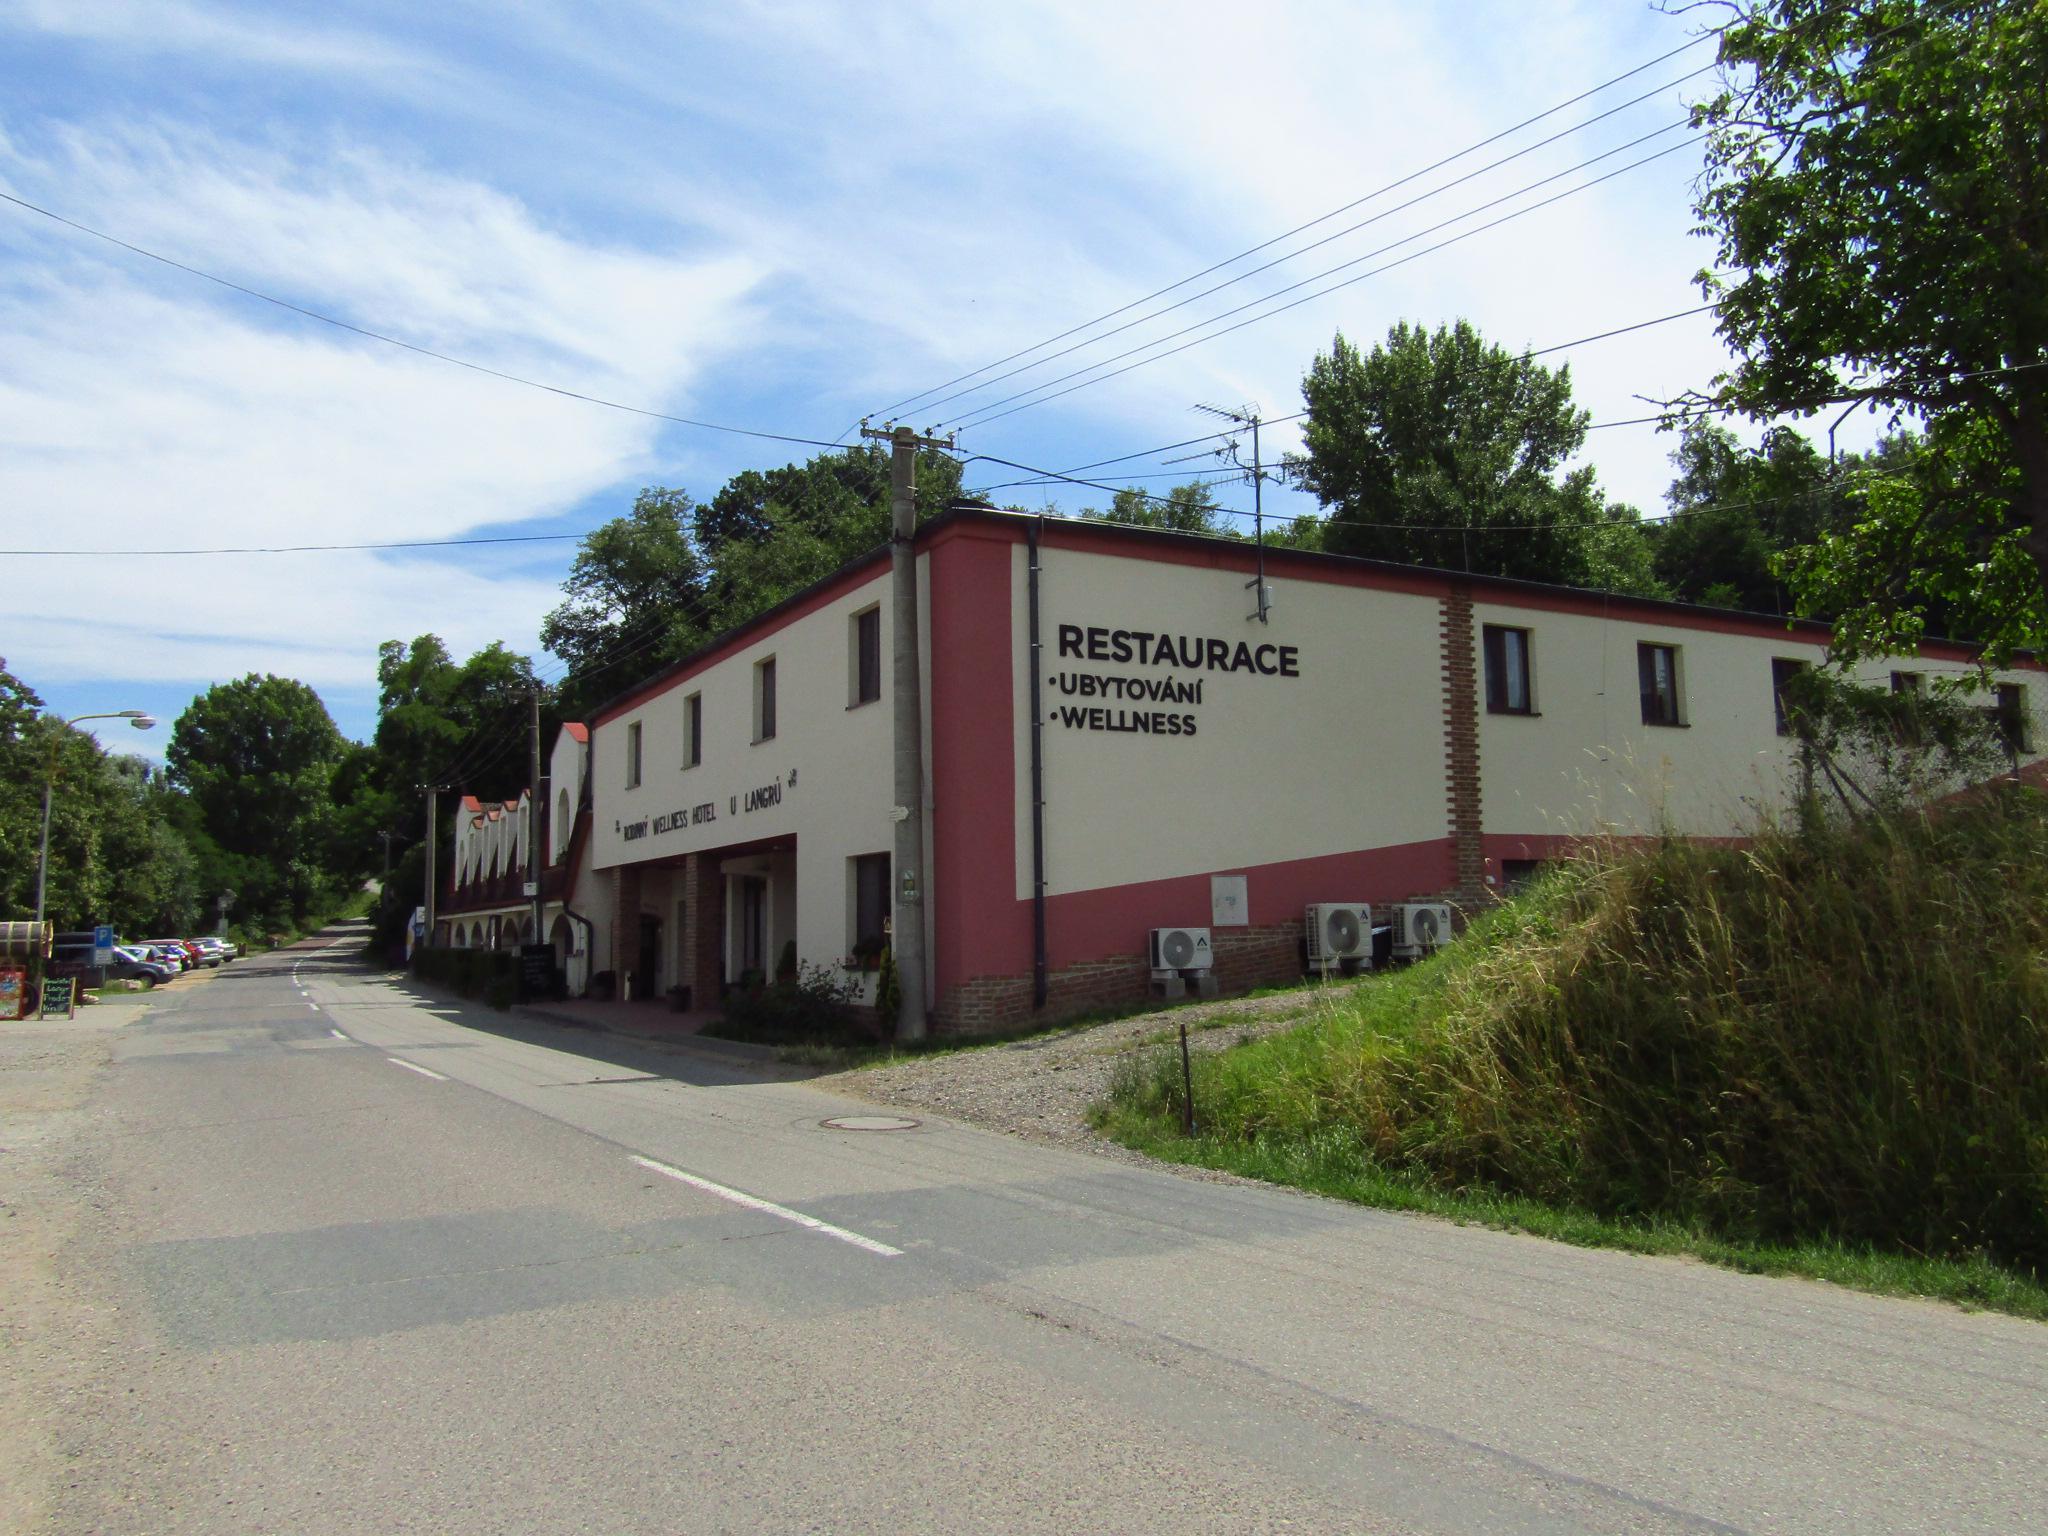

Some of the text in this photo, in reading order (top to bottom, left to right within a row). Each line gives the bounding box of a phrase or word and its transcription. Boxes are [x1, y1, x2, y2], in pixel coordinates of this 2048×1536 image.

[1058, 624, 1300, 677] RESTAURACE
[1059, 672, 1204, 705] UBYTOVÁNÍ
[1060, 706, 1197, 736] WELLNESS
[653, 810, 688, 835] WELLNESS
[692, 802, 717, 826] HOTEL
[730, 796, 737, 815] U
